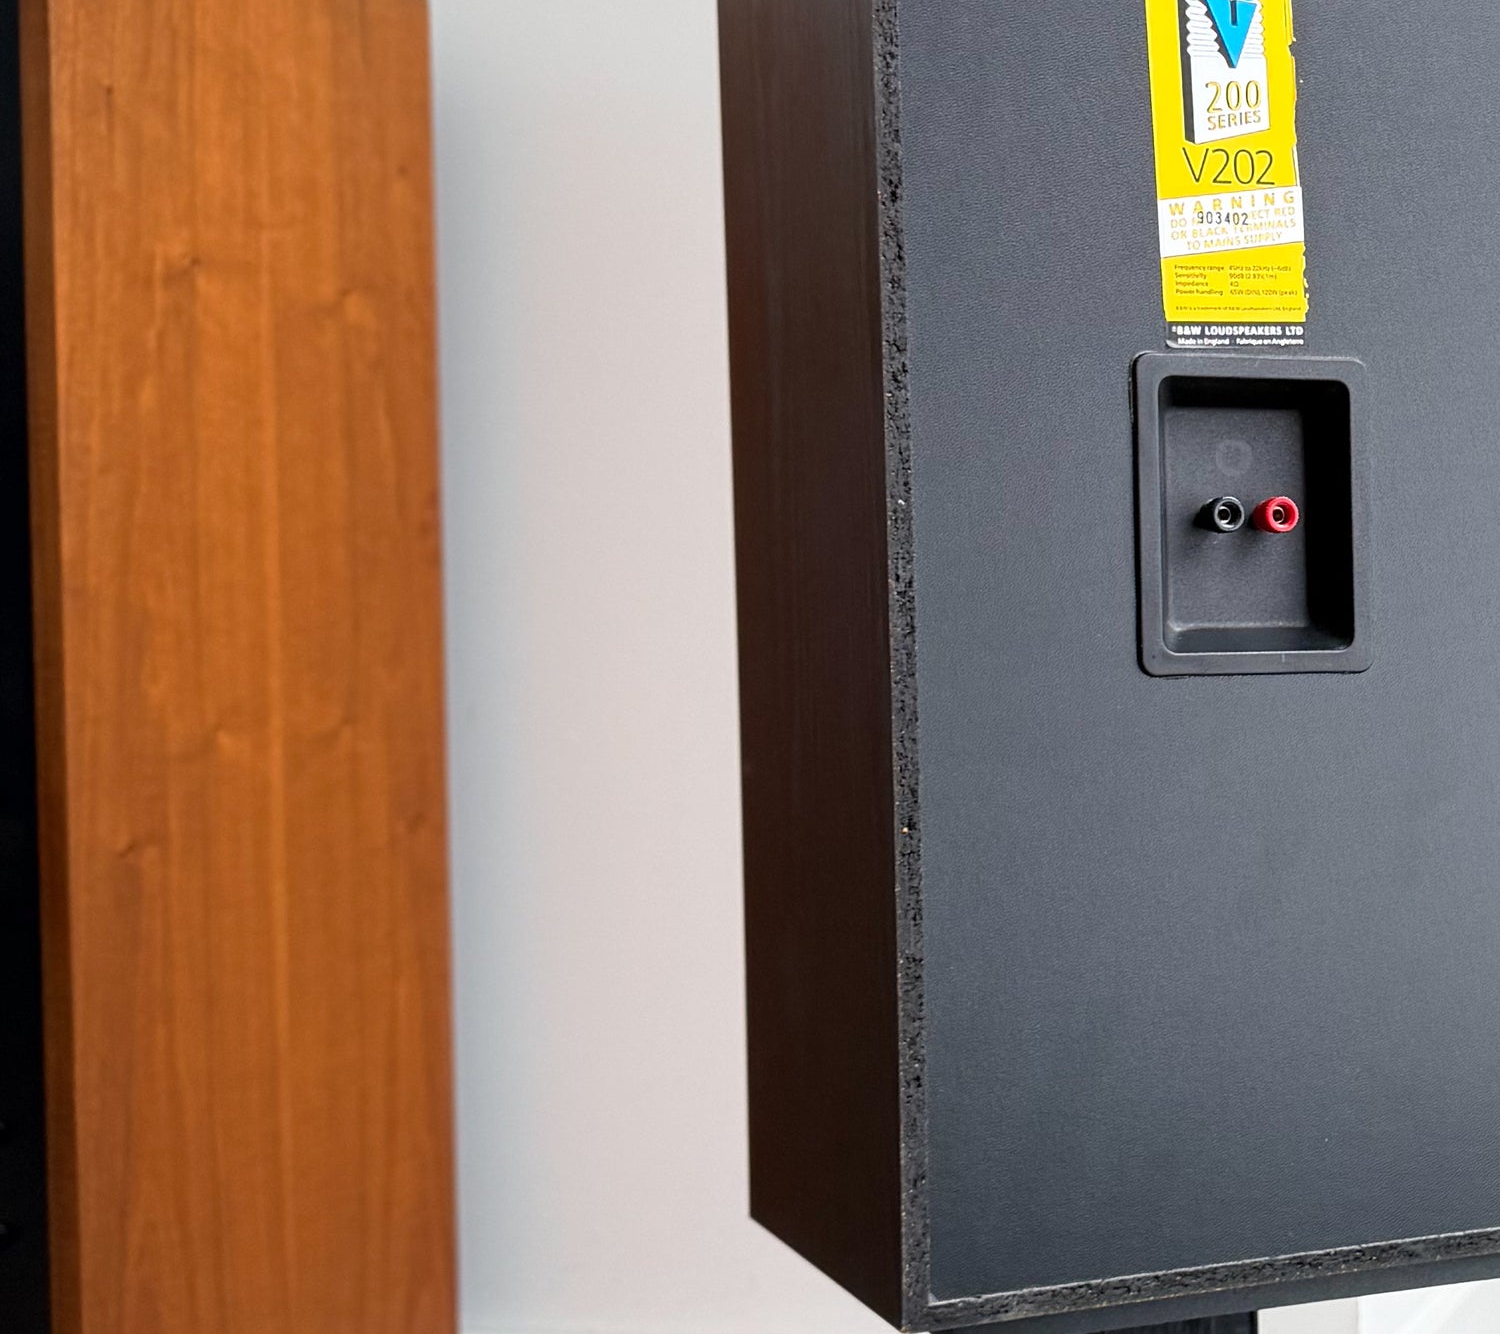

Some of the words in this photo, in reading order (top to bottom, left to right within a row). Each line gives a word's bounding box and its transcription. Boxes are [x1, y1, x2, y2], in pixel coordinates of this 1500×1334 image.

[1205, 79, 1262, 114] 200
[1207, 110, 1262, 131] SERIES
[1182, 146, 1276, 186] V202
[1196, 210, 1249, 226] 903402
[1204, 325, 1283, 336] LOUDSPEAKERS
[1285, 325, 1304, 336] LTD
